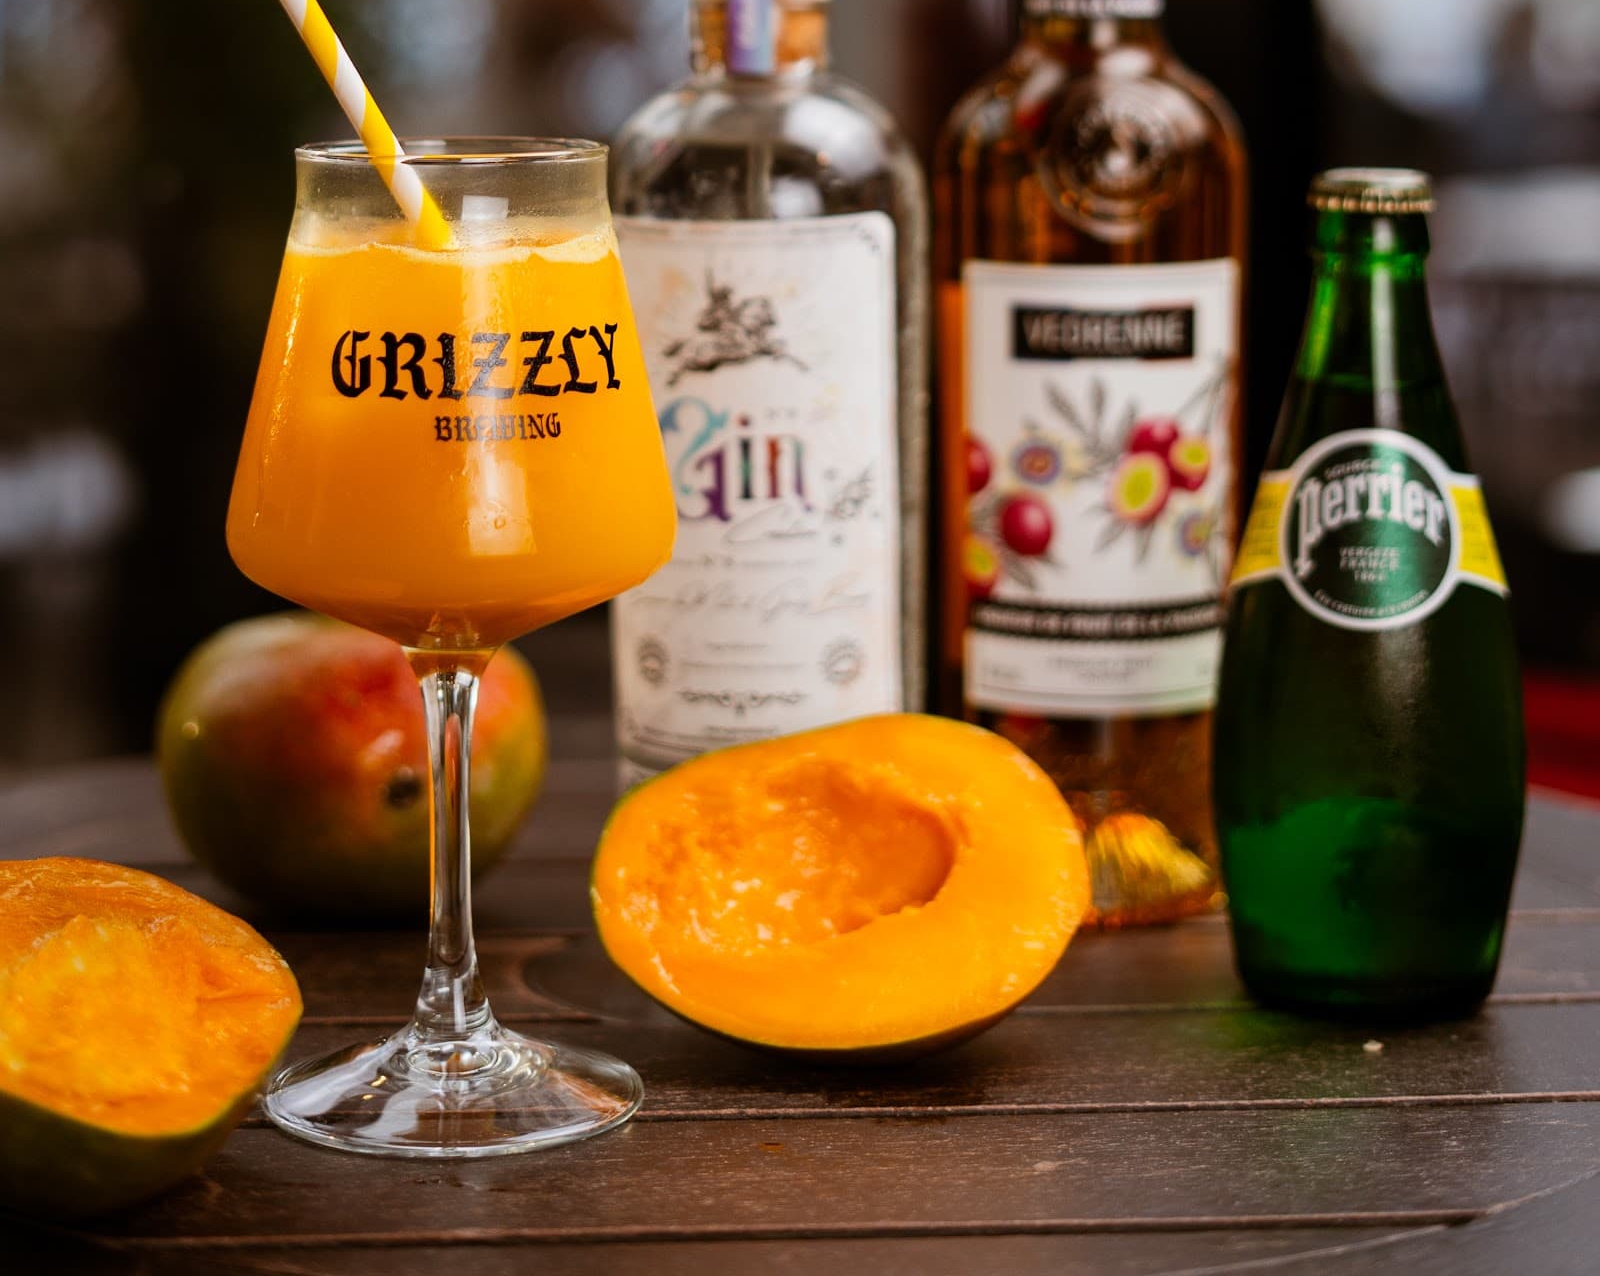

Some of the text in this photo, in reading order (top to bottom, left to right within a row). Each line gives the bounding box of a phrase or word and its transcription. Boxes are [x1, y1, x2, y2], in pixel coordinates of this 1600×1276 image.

[331, 322, 621, 401] GRIZZLY
[434, 412, 561, 443] BREWING
[659, 394, 815, 523] Gin
